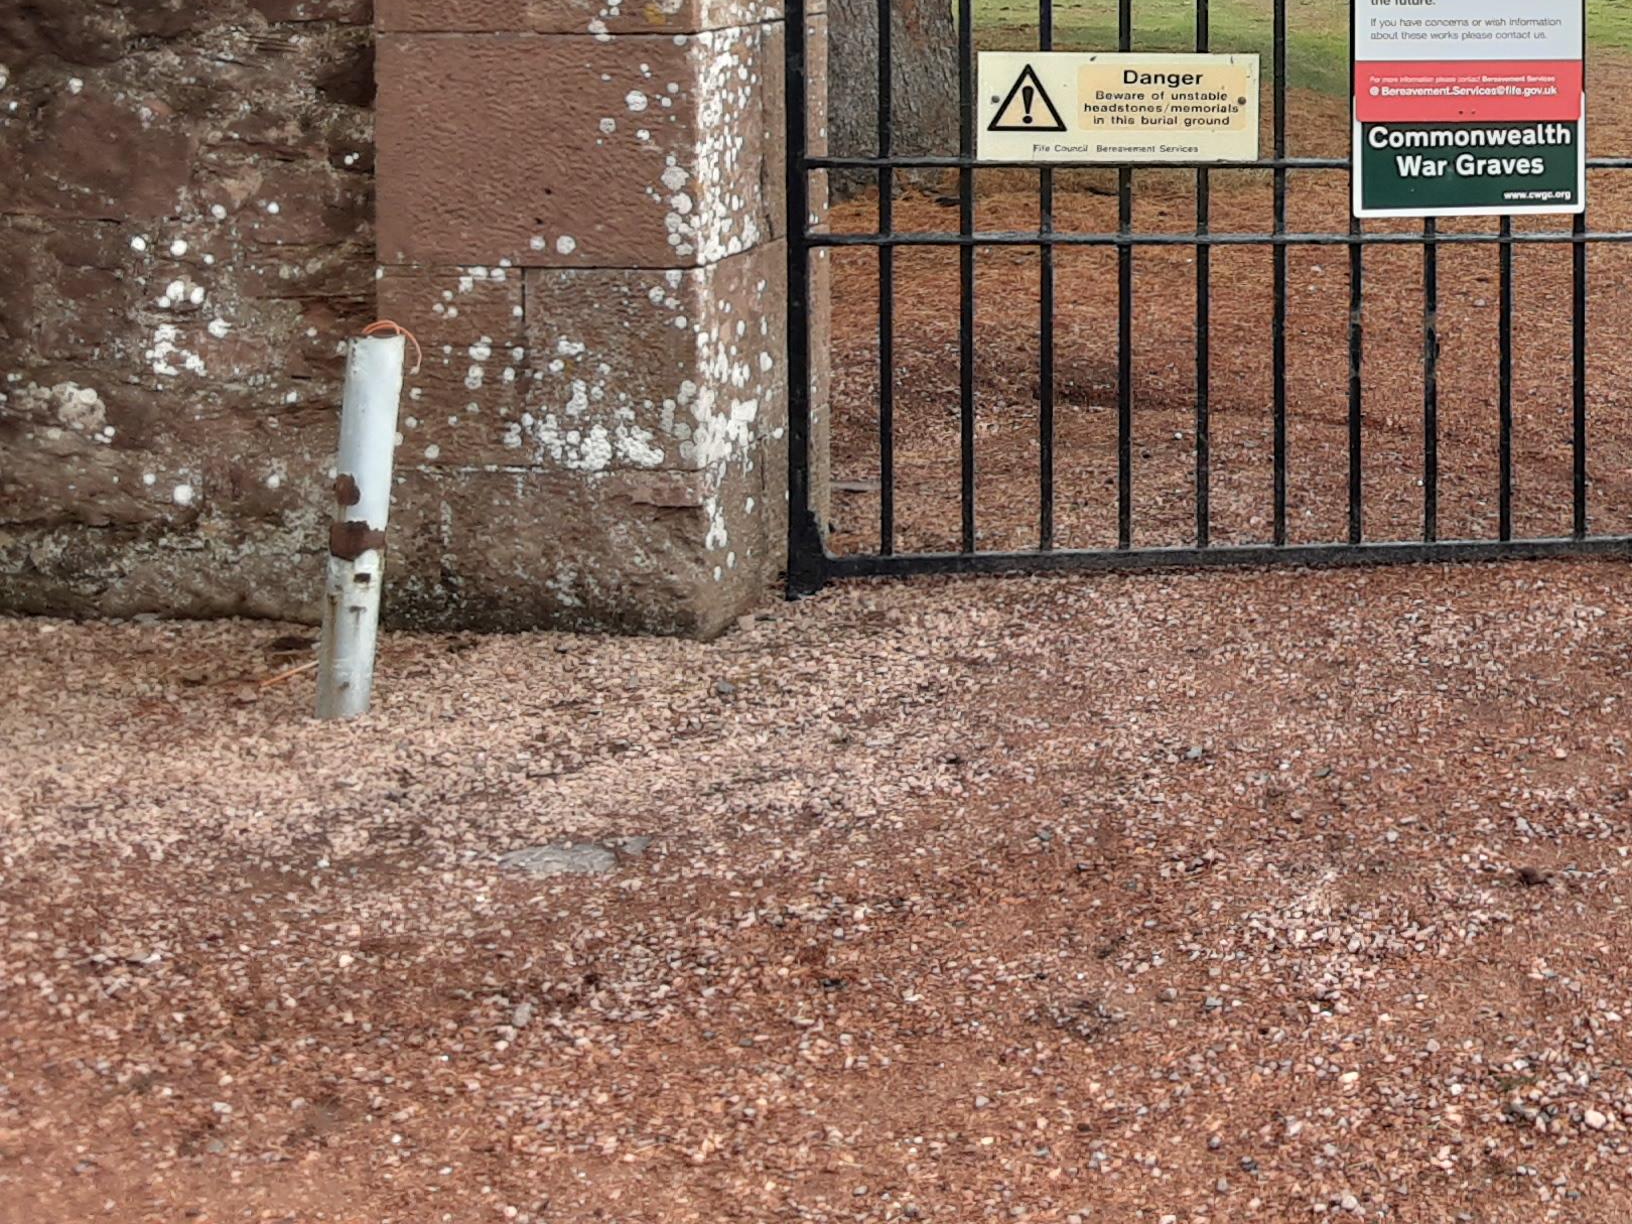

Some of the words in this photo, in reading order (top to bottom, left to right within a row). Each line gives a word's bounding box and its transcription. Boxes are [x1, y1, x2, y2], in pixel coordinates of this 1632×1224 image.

[1370, 18, 1377, 26] If
[1379, 19, 1396, 29] you
[1400, 18, 1422, 27] have
[1424, 19, 1469, 27] concerns
[1484, 18, 1506, 26] wish
[1509, 17, 1562, 26] information
[1370, 31, 1398, 40] about
[1401, 31, 1427, 40] these
[1430, 31, 1458, 40] works
[1461, 31, 1493, 41] please
[1495, 31, 1531, 39] contact
[1123, 69, 1203, 88] Danger
[1095, 90, 1145, 100] Beware
[1151, 91, 1164, 100] of
[1171, 91, 1228, 101] unstable
[1381, 86, 1557, 97] Bereavement.Services@fife.gov.uk
[1084, 103, 1239, 113] headstones/memorials
[1093, 116, 1104, 125] in
[1111, 116, 1135, 125] this
[1141, 116, 1178, 125] burial
[1184, 116, 1230, 127] ground
[1368, 123, 1571, 149] Commonwealth
[1033, 144, 1050, 152] Fife
[1054, 144, 1088, 152] Council
[1096, 144, 1155, 152] Bereavement
[1160, 144, 1198, 152] Services
[1396, 154, 1448, 177] War
[1456, 153, 1544, 176] Graves
[1503, 191, 1571, 201] www.cwgc.org
